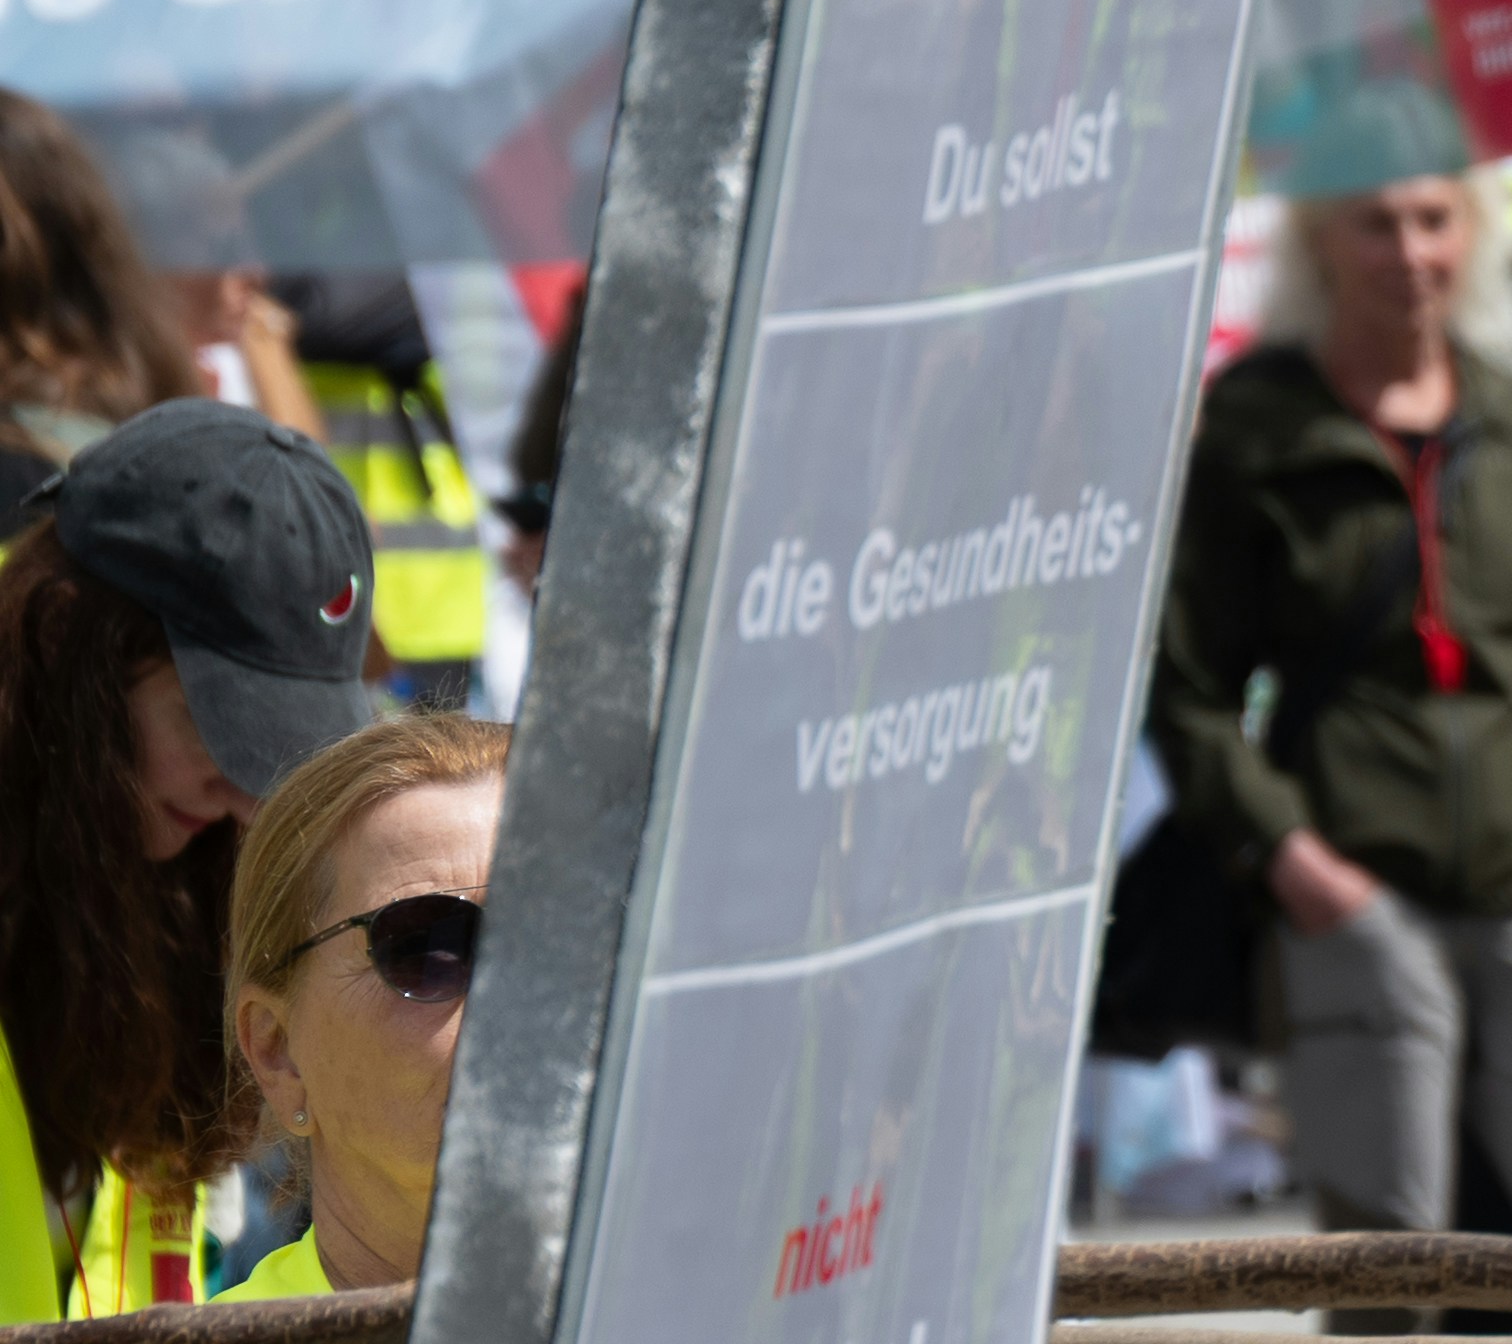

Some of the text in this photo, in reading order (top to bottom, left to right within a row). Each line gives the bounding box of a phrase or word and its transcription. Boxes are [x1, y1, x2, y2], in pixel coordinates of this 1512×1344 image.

[923, 88, 1119, 225] Du sollst
[739, 483, 1144, 642] die Gesundheits-
[797, 663, 1053, 794] versorgung
[773, 1182, 884, 1300] nicht
